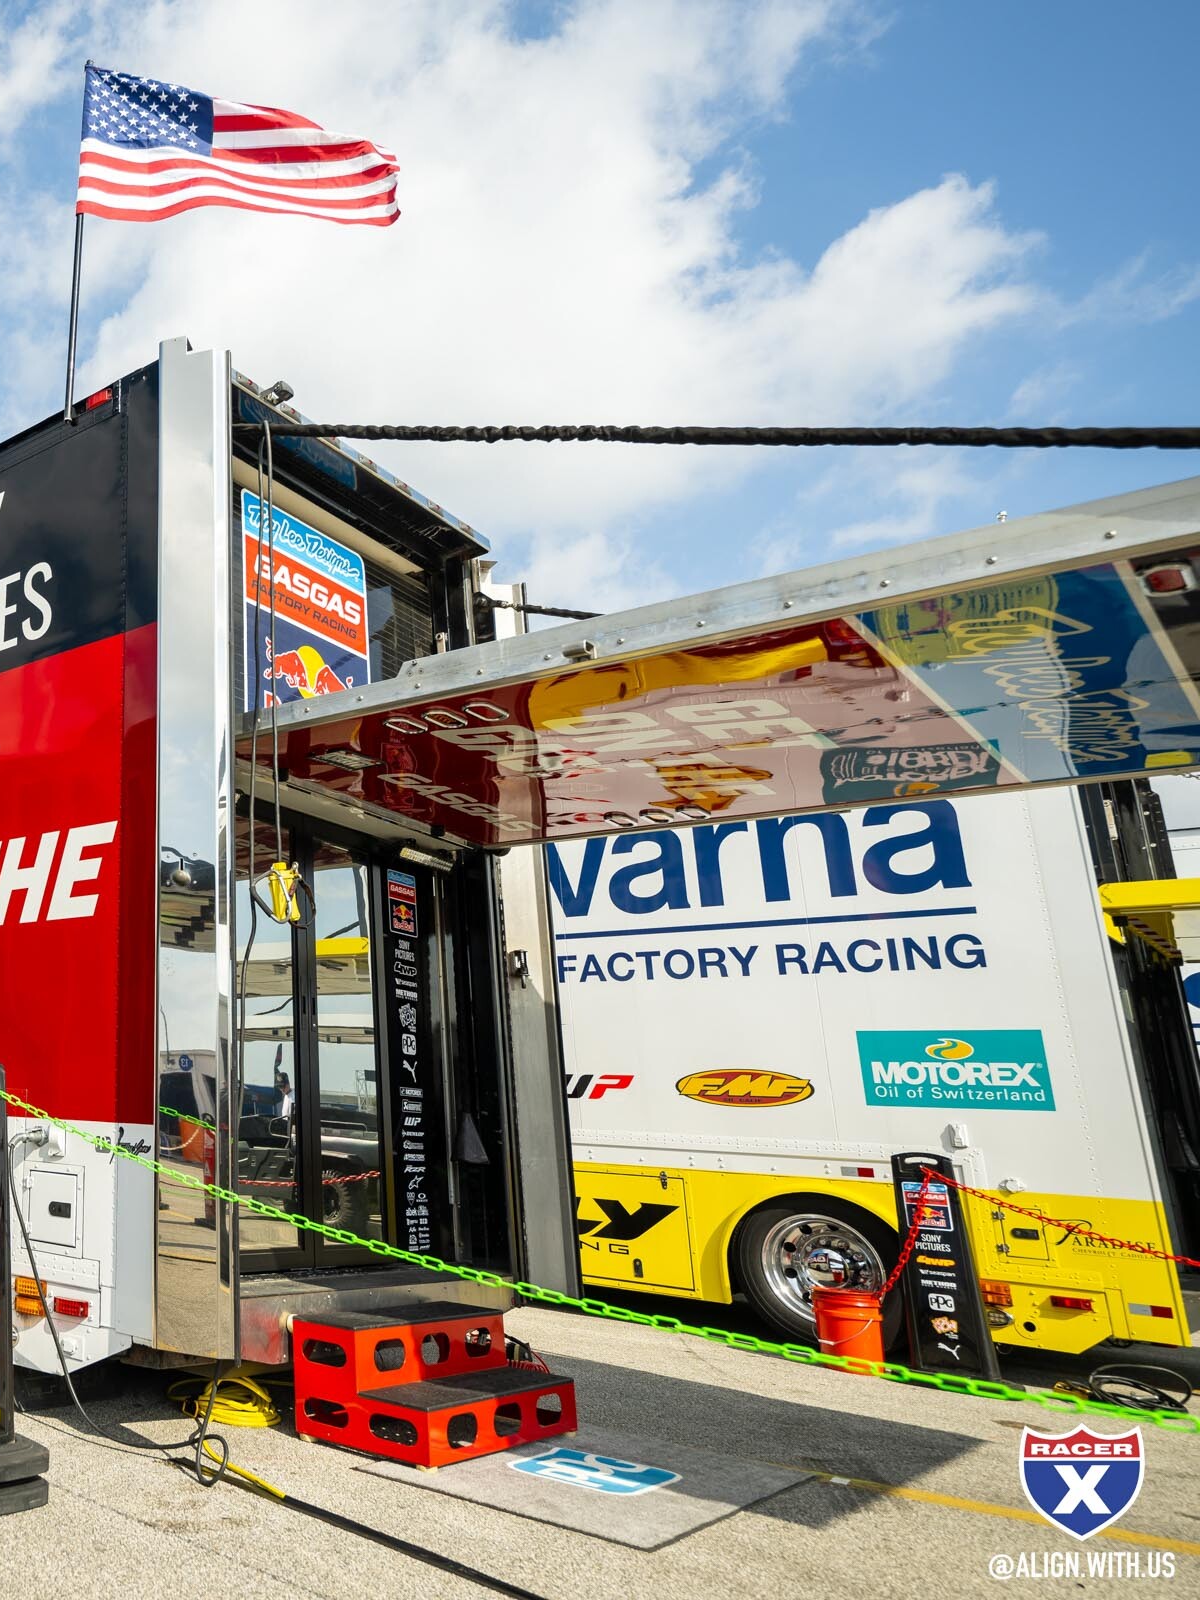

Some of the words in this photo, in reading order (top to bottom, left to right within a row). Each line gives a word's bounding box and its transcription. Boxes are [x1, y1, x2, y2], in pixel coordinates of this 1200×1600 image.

[279, 519, 307, 551] Lee
[305, 535, 360, 579] Designs
[254, 553, 361, 625] GASGAS
[251, 579, 311, 618] FACTORY
[312, 607, 357, 640] RACING
[558, 945, 758, 983] FACTORY
[775, 933, 987, 976] RACING
[679, 1074, 810, 1098] FMF
[871, 1061, 1041, 1087] MOTOREX
[875, 1085, 899, 1098] Oil
[906, 1086, 923, 1099] of
[931, 1087, 1046, 1102] Switzerland
[404, 1116, 421, 1126] WP
[915, 1241, 951, 1252] PICTURES
[921, 1233, 941, 1243] SONY
[930, 1296, 953, 1309] PPG
